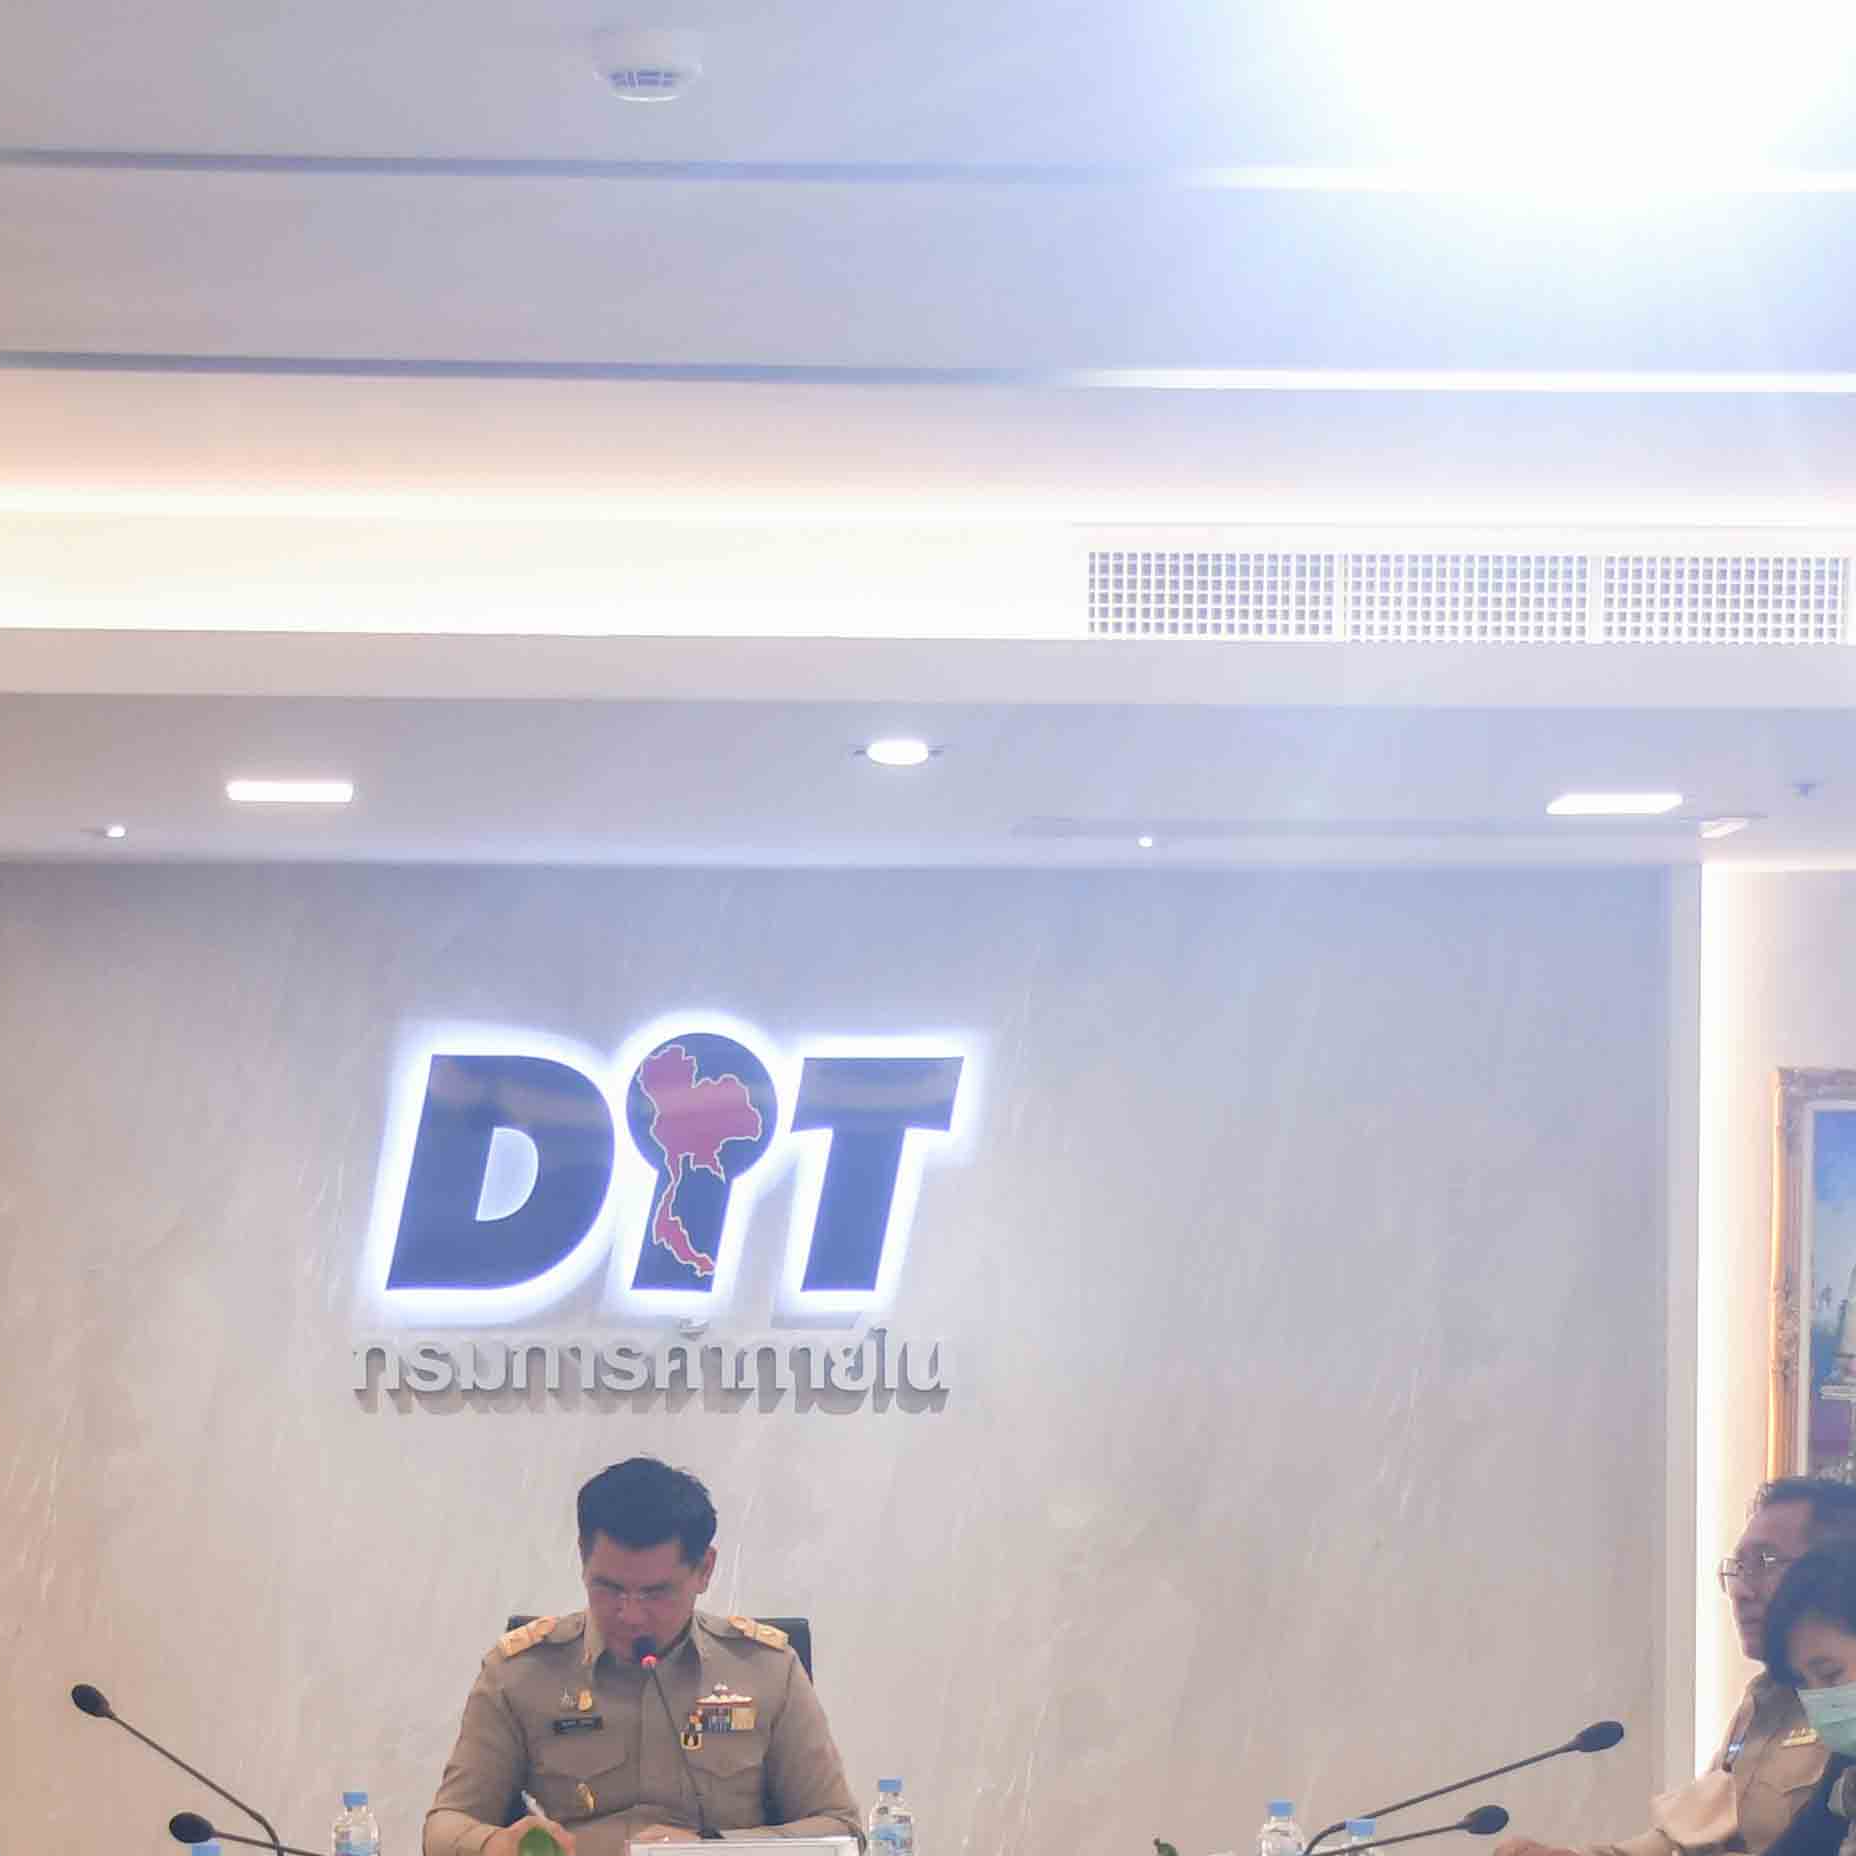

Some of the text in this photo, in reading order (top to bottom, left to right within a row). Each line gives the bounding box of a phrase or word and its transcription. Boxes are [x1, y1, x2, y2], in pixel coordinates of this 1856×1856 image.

[350, 1316, 951, 1396] กรมการค้าภายใน
